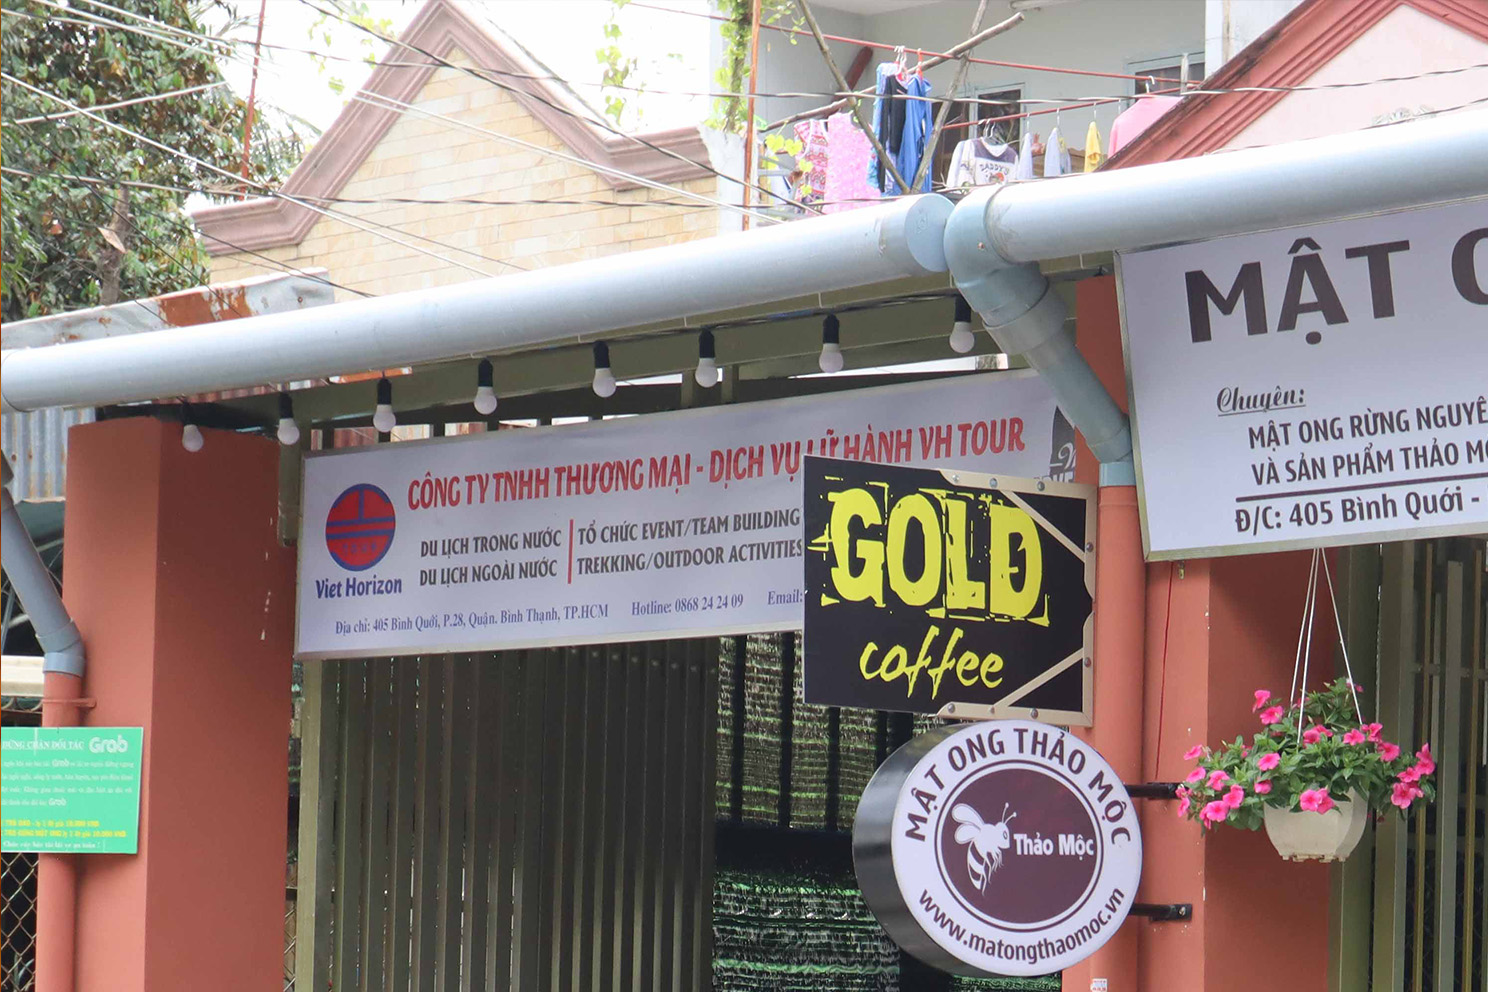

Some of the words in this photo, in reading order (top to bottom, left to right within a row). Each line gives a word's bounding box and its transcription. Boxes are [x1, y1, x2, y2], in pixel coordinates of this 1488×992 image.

[1184, 237, 1410, 345] MẬT
[1216, 385, 1305, 413] Chuyên:
[1248, 420, 1292, 451] MẬT
[1299, 417, 1344, 445] ONG
[1349, 407, 1410, 439] RỪNG
[407, 471, 461, 511] CÔNG
[465, 473, 490, 505] TY
[492, 467, 550, 502] TNHH
[554, 458, 644, 497] THƯƠNG
[649, 453, 691, 494] MẠI
[709, 445, 765, 490] DỊCH
[770, 440, 801, 483] VỤ
[843, 424, 913, 463] HÀNH
[918, 424, 953, 461] VH
[957, 416, 1026, 457] TOUR
[1251, 456, 1280, 486] VÀ
[1285, 452, 1327, 483] SẢN
[1333, 442, 1395, 478] PHẨM
[1399, 437, 1460, 471] THẢO
[577, 519, 597, 545] TỔ
[600, 519, 638, 544] CHỨC
[642, 515, 730, 541] EVENT/TEAM
[733, 507, 801, 532] BUILDING
[1235, 506, 1282, 536] Đ/C:
[1289, 500, 1334, 528] 405
[1341, 493, 1398, 523] Bình
[1405, 486, 1464, 518] Quới
[420, 540, 438, 557] DU
[441, 536, 469, 560] LỊCH
[473, 533, 519, 553] TRONG
[522, 526, 562, 550] NƯỚC
[576, 545, 725, 576] TREKKING/OUTDOOR
[728, 538, 803, 564] ACTIVITIES
[826, 486, 1045, 622] GOLD
[315, 578, 343, 599] Viet
[345, 574, 403, 598] Horizon
[419, 569, 437, 586] DU
[440, 565, 468, 589] LỊCH
[471, 560, 515, 582] NGOÀI
[518, 556, 558, 580] NƯỚC
[631, 601, 672, 616] Hotline:
[674, 597, 699, 613] 0868
[702, 596, 714, 611] 24
[716, 595, 729, 610] 24
[731, 593, 744, 608] 09
[767, 589, 803, 605] Email:
[335, 620, 351, 636] Địa
[353, 617, 371, 634] chỉ:
[373, 618, 389, 632] 405
[391, 616, 413, 631] Bình
[443, 613, 467, 629] P.28,
[500, 608, 524, 624] Bình
[563, 604, 609, 621] TP.HCM
[859, 625, 1004, 700] coffee
[88, 734, 128, 754] Grab
[905, 764, 946, 842] MẬT
[947, 729, 1005, 772] ONG
[1013, 727, 1086, 775] THẢO
[1088, 771, 1131, 845] MỘC
[1013, 832, 1054, 856] Thảo
[1058, 833, 1095, 861] Mộc
[919, 887, 1126, 965] www.matongthaomoc.vn
